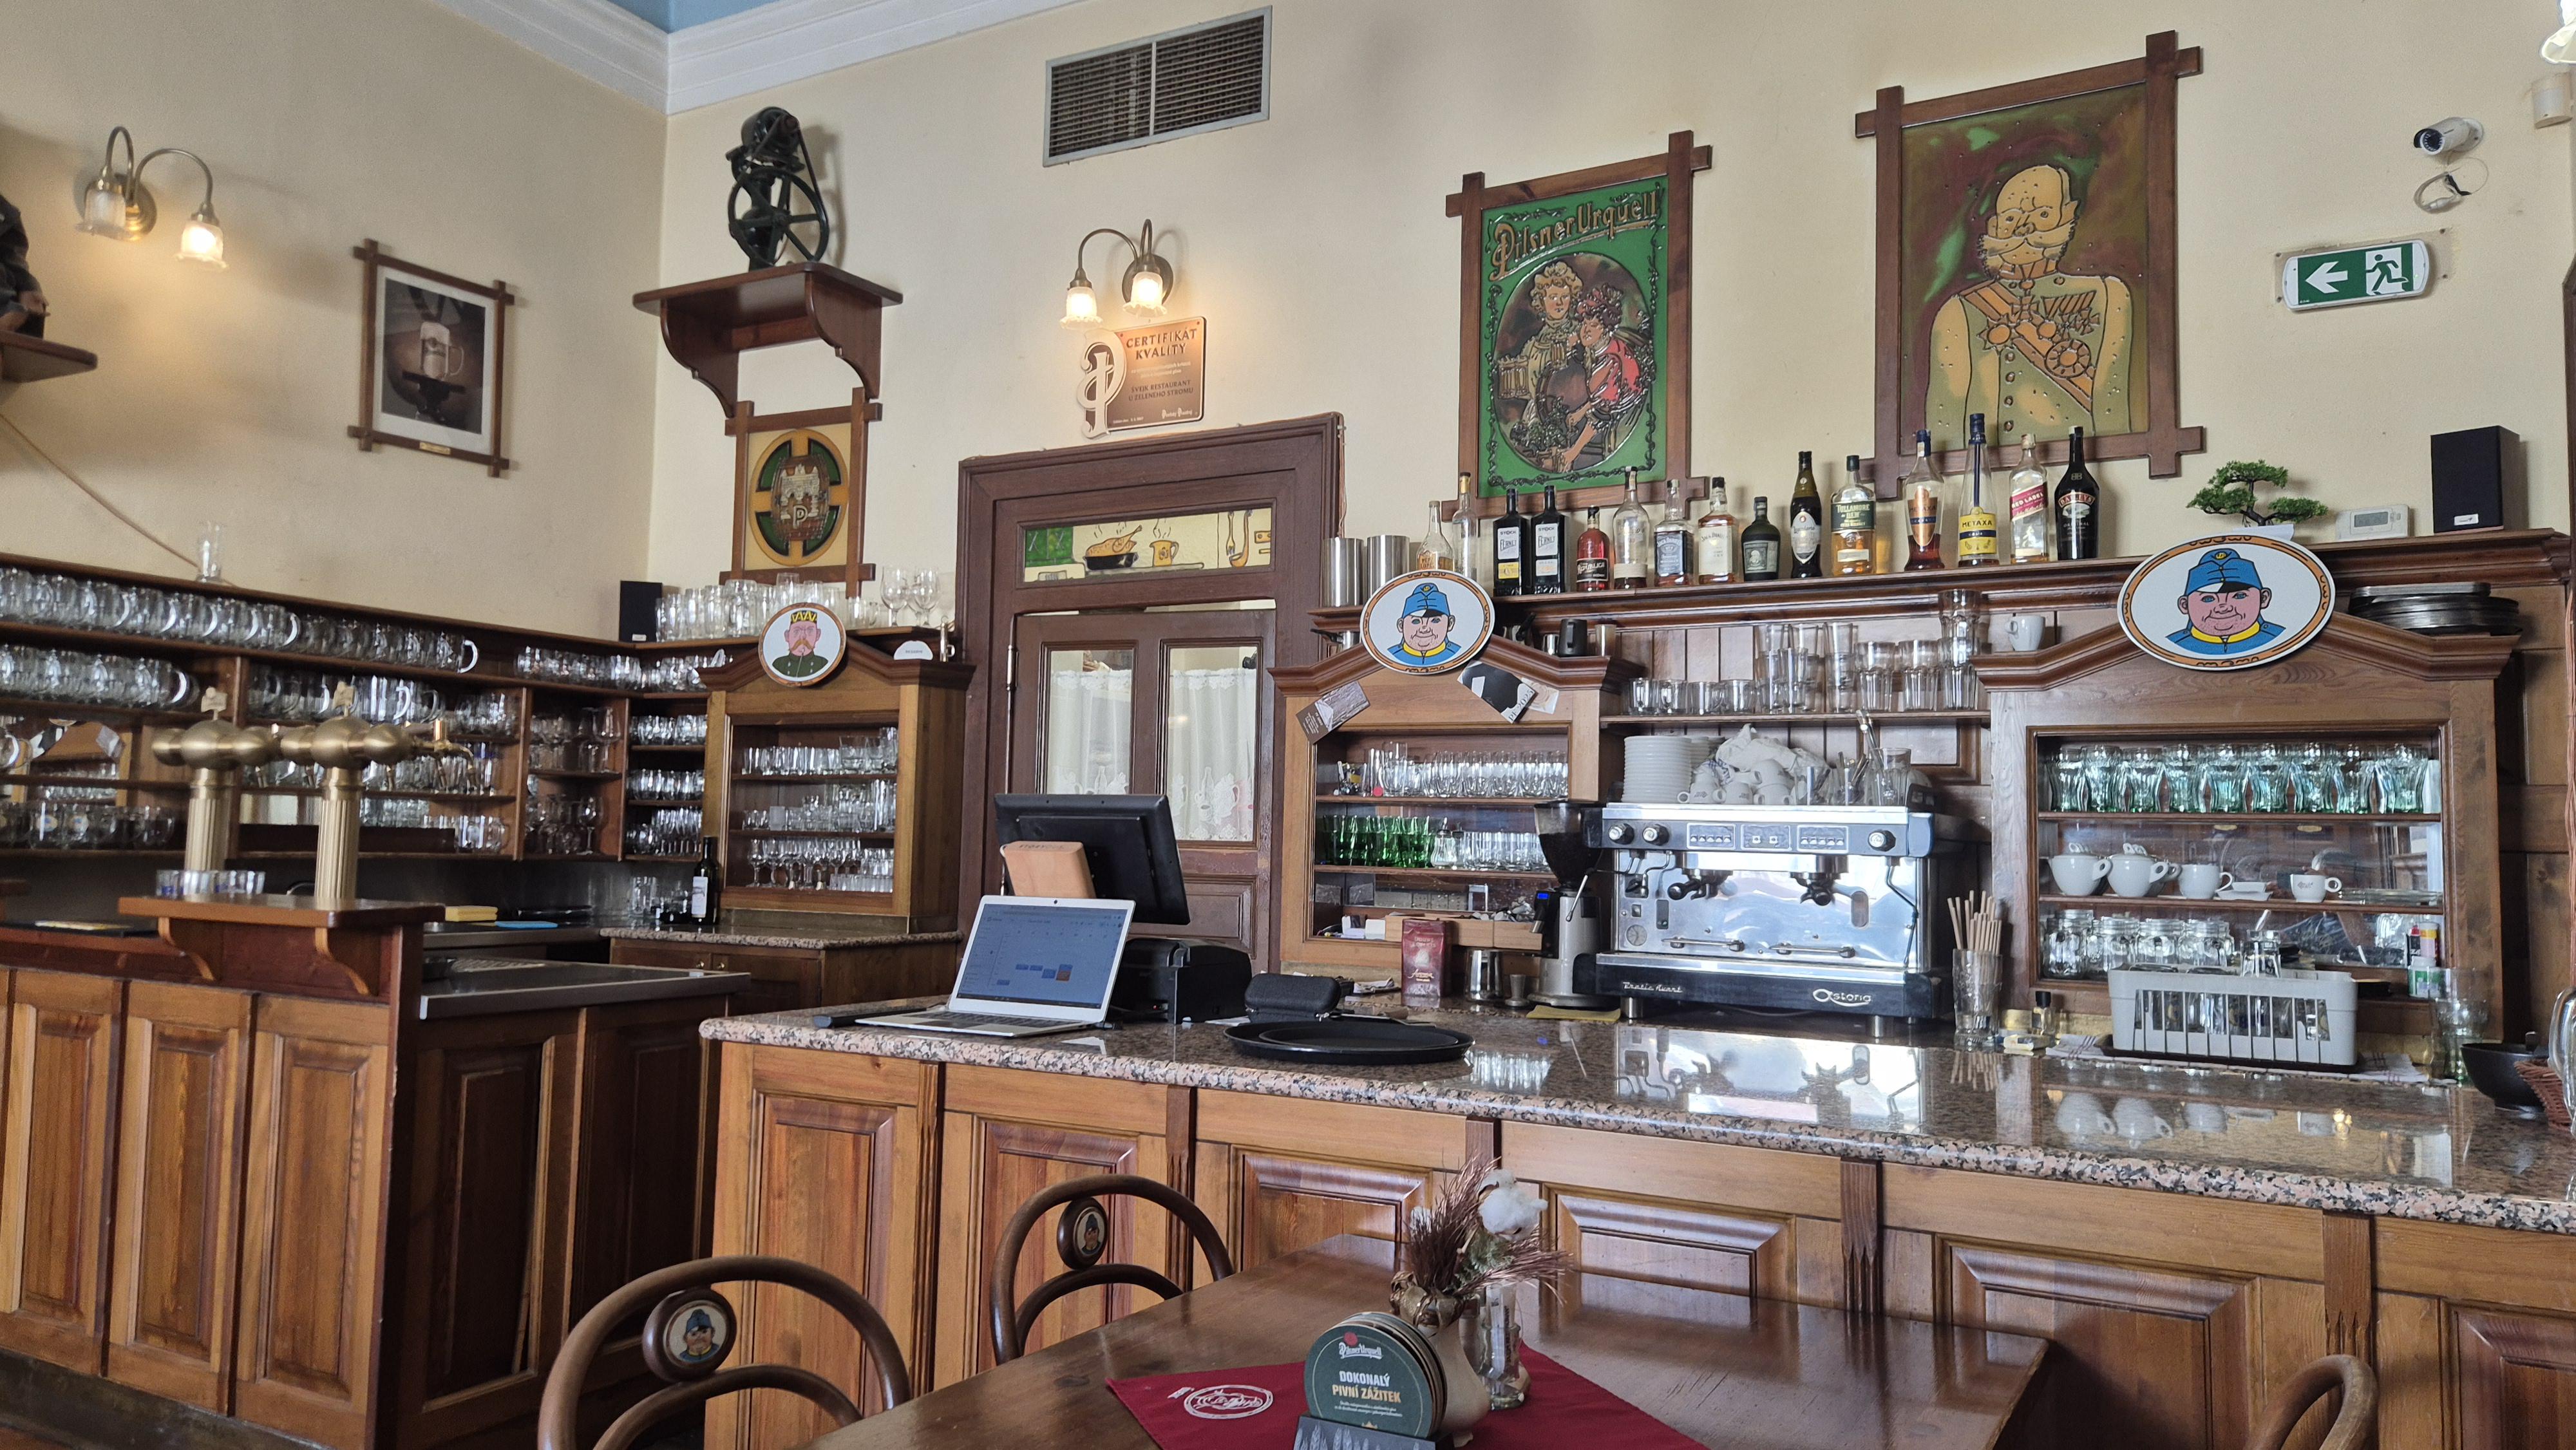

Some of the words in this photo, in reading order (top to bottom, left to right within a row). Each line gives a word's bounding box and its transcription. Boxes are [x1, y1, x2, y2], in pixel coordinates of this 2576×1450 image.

[1489, 218, 1575, 282] Pilsner
[1577, 191, 1660, 240] Urquell
[1126, 327, 1197, 348] CERTIFIKÁT
[1136, 343, 1186, 360] KVALITY
[1150, 380, 1191, 390] RESTAURANT
[1909, 504, 1937, 513] MEAXA
[2060, 494, 2092, 506] BAEYS
[1962, 520, 1993, 528] METAXA
[1812, 988, 1871, 1007] Astoria
[1338, 1342, 1360, 1359] Pilsner
[1359, 1342, 1382, 1359] Urquell
[1339, 1370, 1390, 1388] DOKONALÝ
[1332, 1384, 1359, 1398] PIVNÍ
[1360, 1386, 1402, 1404] ZÁŽITEK
